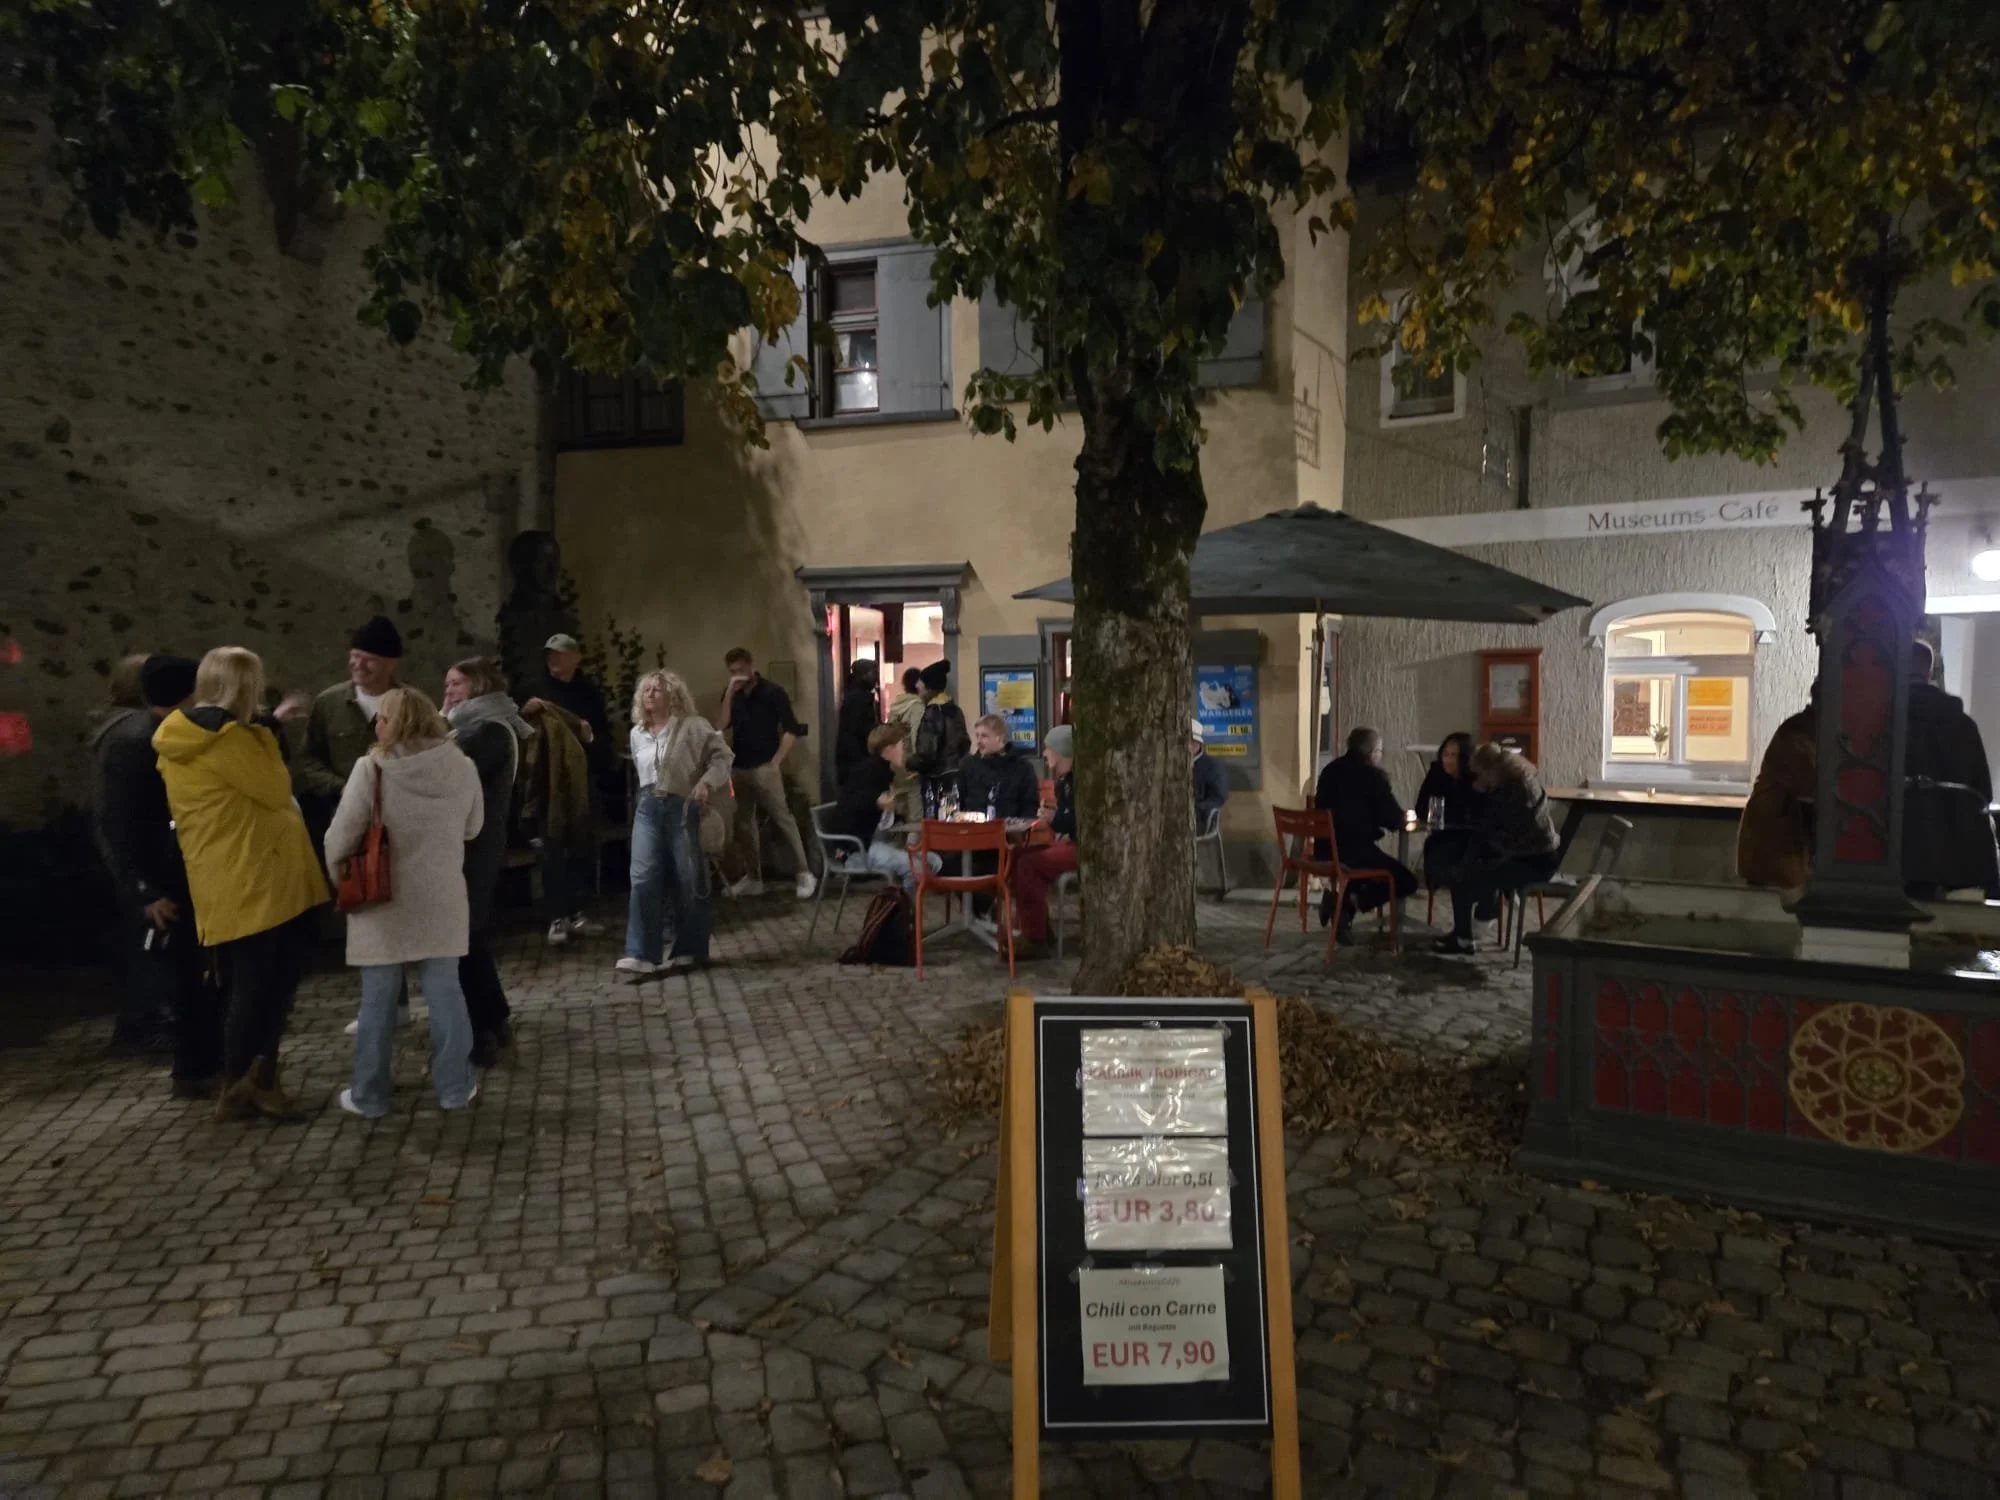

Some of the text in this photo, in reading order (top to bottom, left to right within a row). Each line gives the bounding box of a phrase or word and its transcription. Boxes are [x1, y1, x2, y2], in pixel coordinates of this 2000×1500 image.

[1094, 1199, 1216, 1226] EUR 3,80
[1086, 1300, 1217, 1318] Chili con Carne
[1092, 1340, 1216, 1369] EUR 7,90
